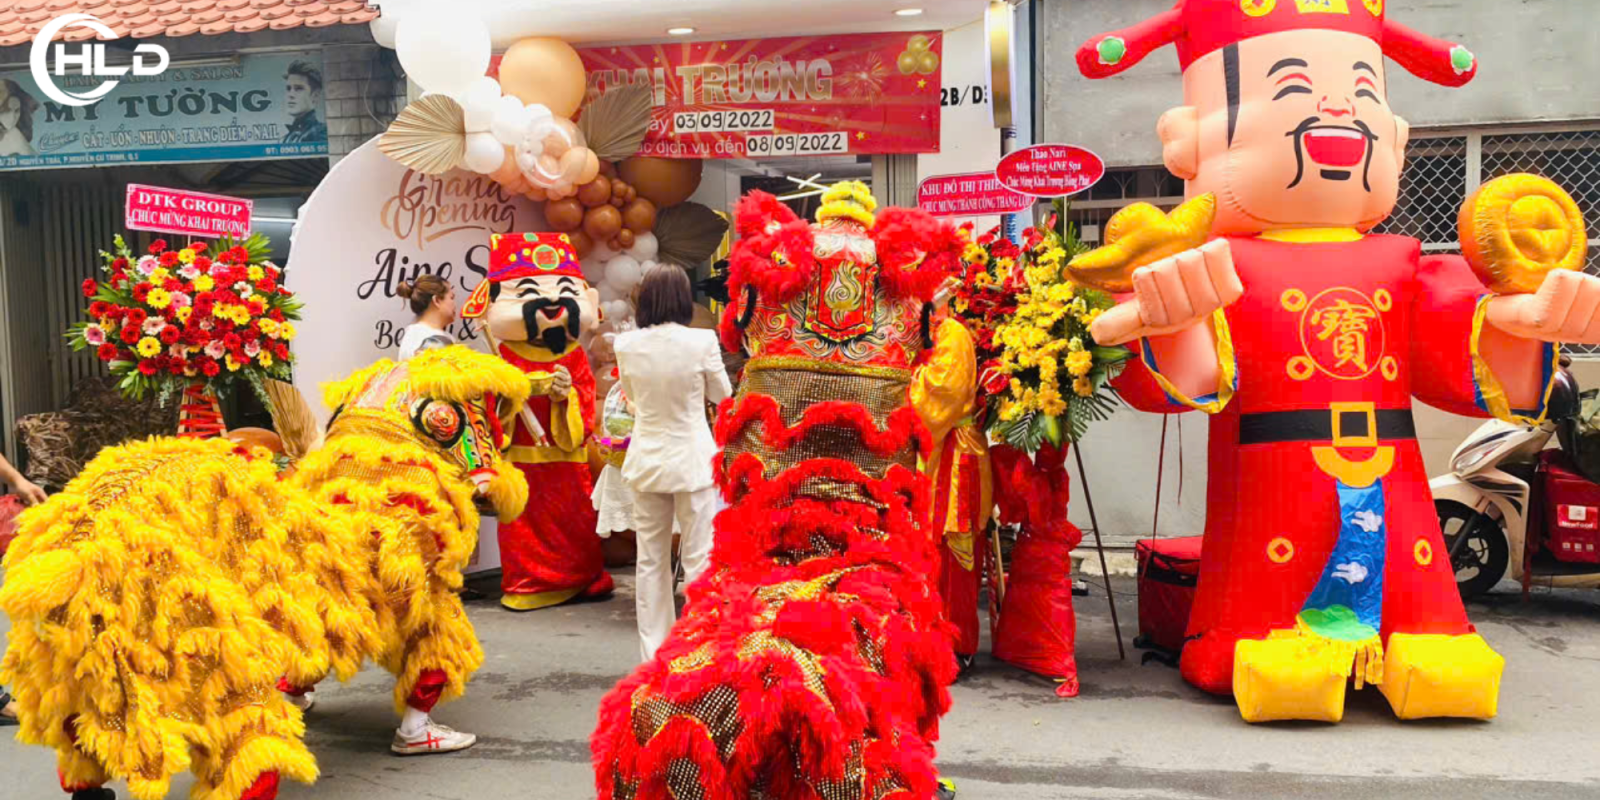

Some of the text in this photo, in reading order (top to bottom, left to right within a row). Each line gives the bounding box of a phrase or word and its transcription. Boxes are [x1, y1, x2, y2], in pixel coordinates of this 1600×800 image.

[191, 66, 244, 81] SALON
[676, 55, 834, 106] TRƯƠNG
[118, 87, 271, 118] TƯỜNG
[675, 110, 773, 130] 03/09/2022
[182, 127, 218, 145] TRANG
[253, 123, 279, 141] NAIL
[656, 140, 687, 157] dịch
[693, 142, 713, 157] vụ
[715, 134, 745, 155] đến
[747, 132, 843, 153] 08/09/2022
[921, 183, 941, 196] KHU
[138, 191, 242, 217] DTK GROUP
[131, 207, 246, 234] CHÚC MỪNG KHAI TRƯƠNG
[380, 195, 517, 251] Opening
